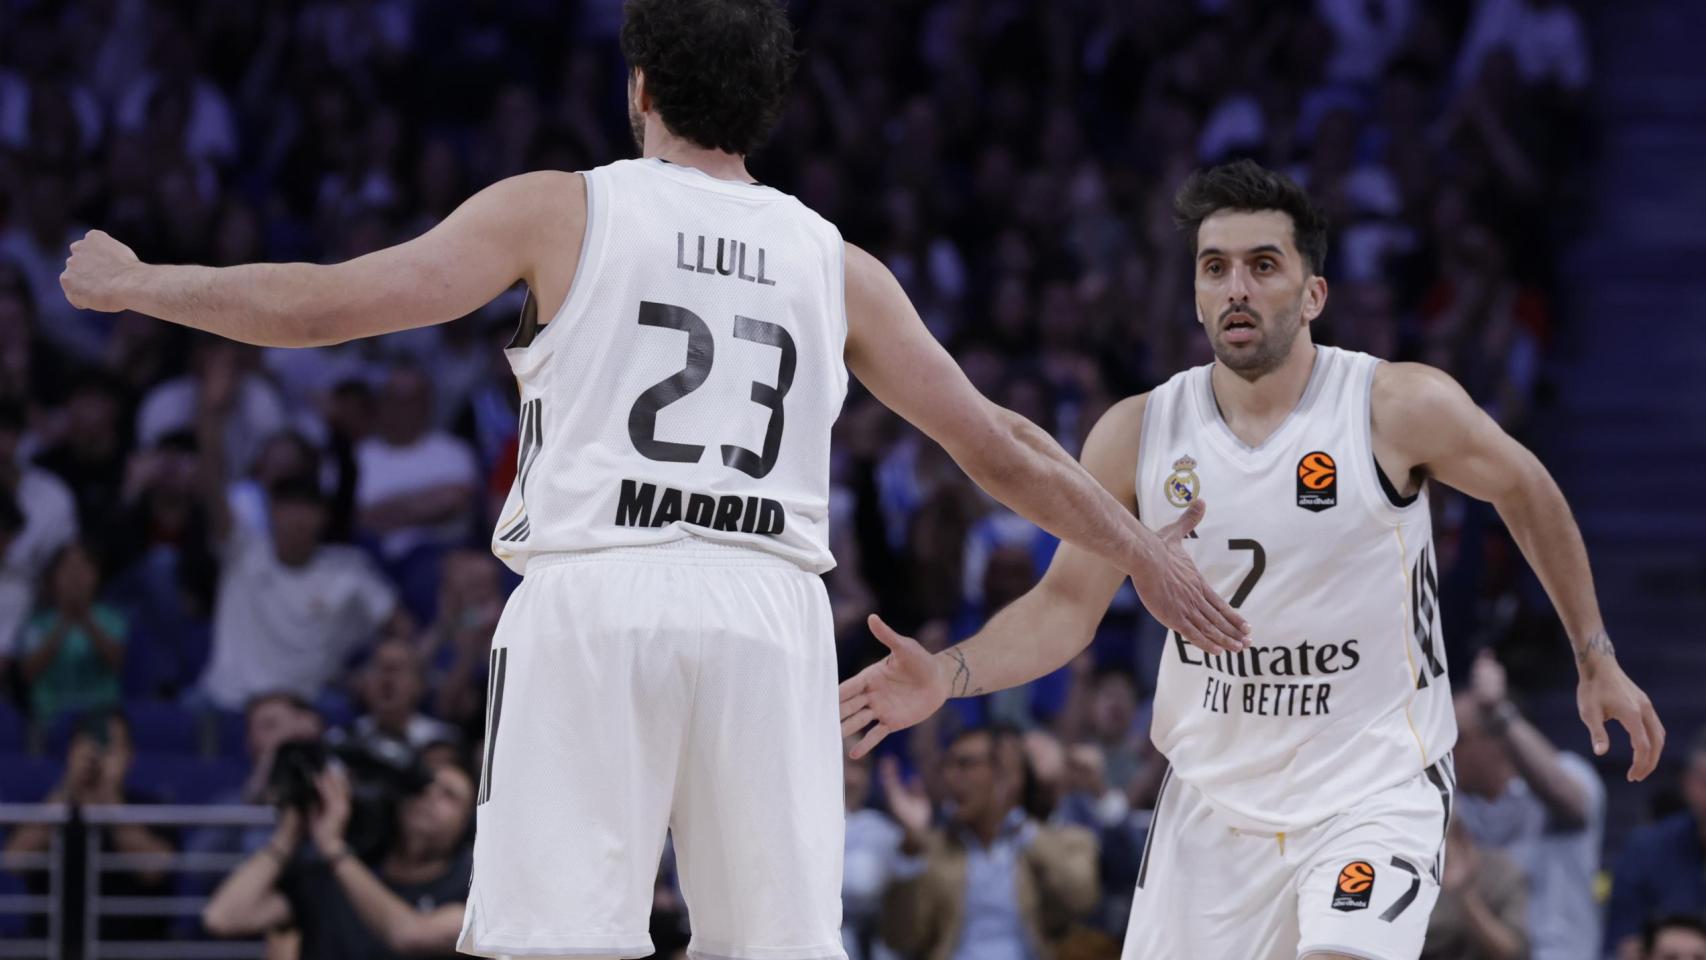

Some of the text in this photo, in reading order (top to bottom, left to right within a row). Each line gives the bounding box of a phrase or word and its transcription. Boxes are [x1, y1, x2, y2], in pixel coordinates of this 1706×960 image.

[677, 232, 776, 286] LLULL
[628, 301, 798, 480] 23
[615, 479, 785, 535] MADRID
[1228, 538, 1266, 609] 7
[1203, 676, 1332, 716] FLY BETTER
[1378, 855, 1421, 923] 7
